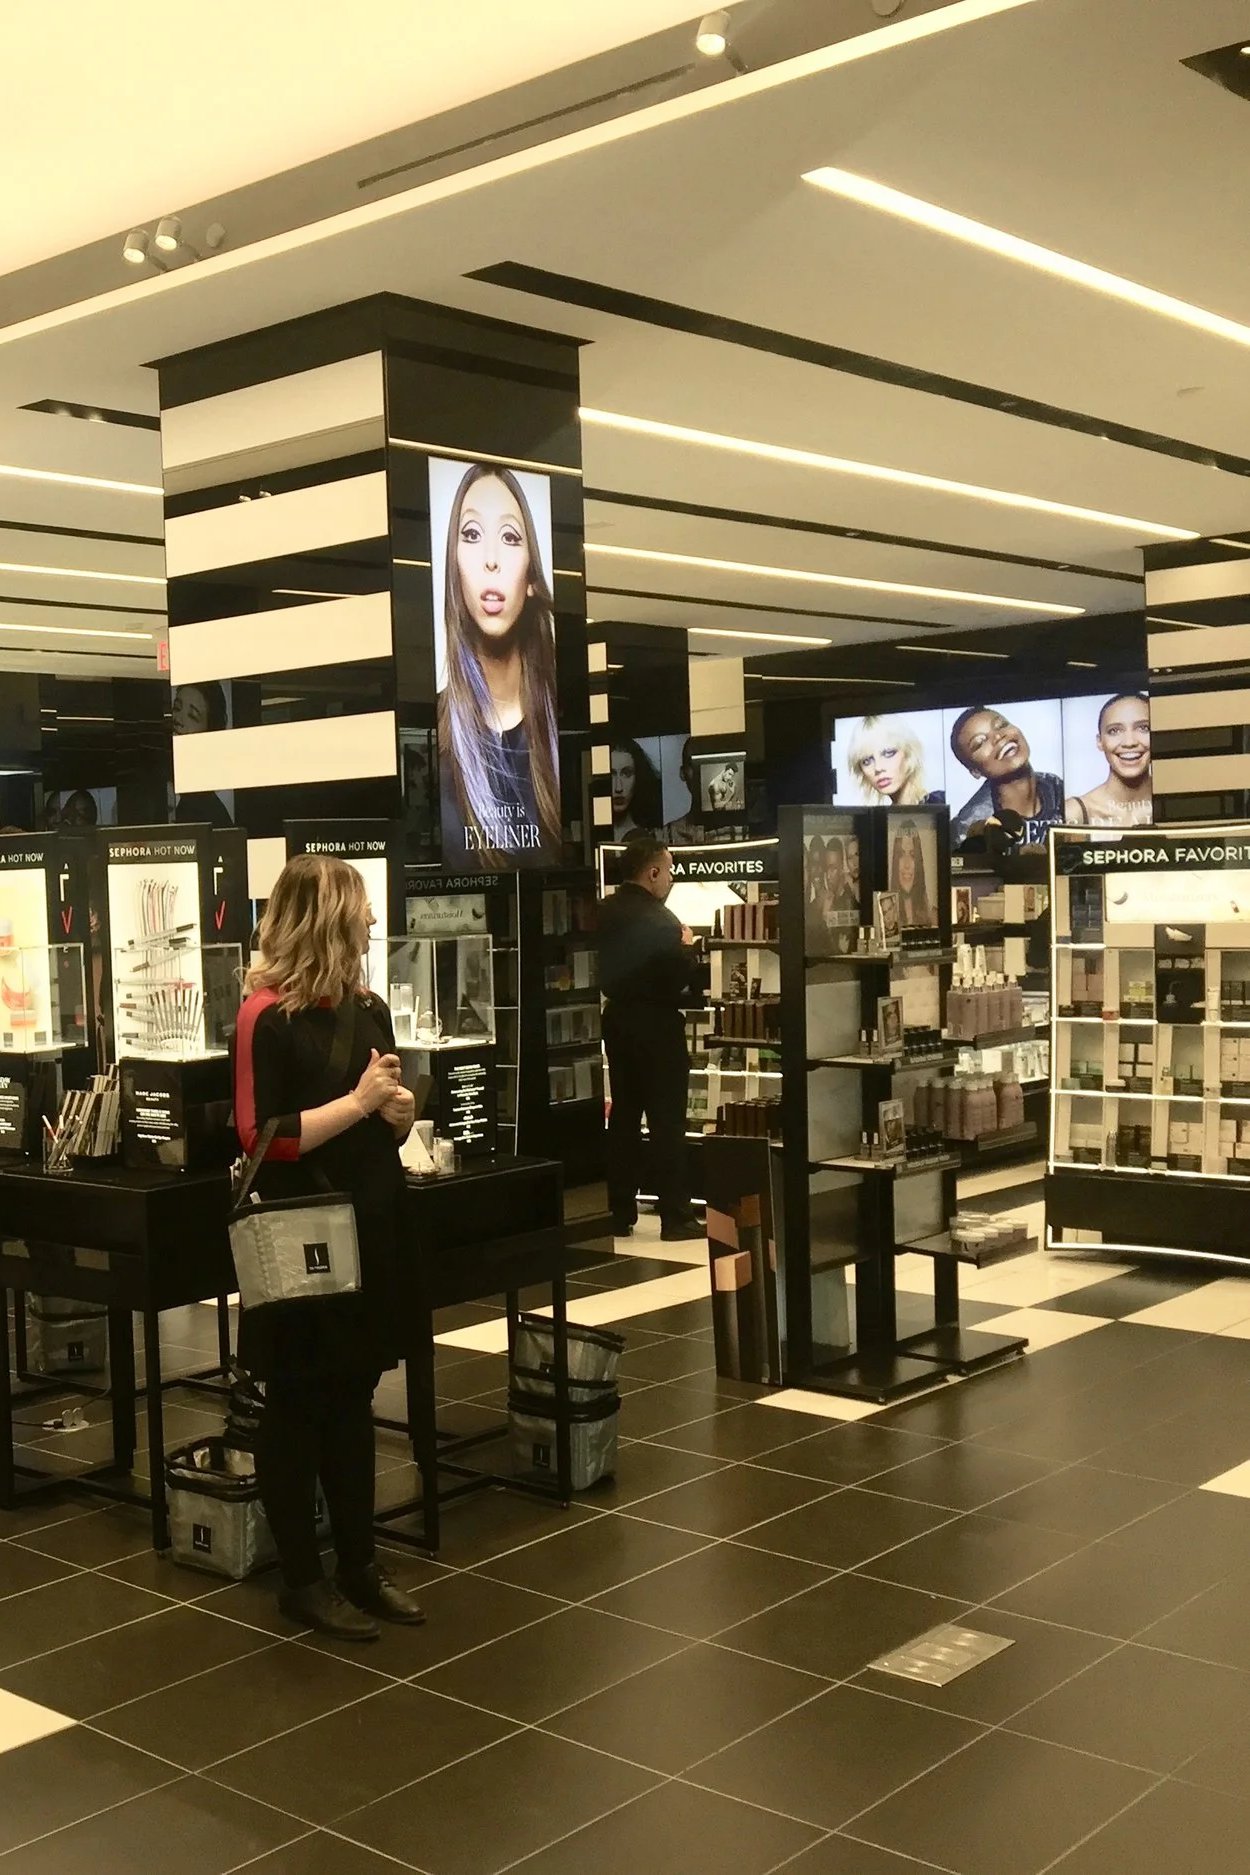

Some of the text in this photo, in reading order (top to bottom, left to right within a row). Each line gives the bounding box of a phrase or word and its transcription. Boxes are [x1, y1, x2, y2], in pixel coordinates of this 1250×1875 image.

[478, 802, 526, 821] Beauty is
[464, 824, 542, 850] EYELINER
[109, 845, 195, 858] SEPHORA HOT NOW
[305, 841, 386, 853] SEPHORA HOT NOW
[8, 854, 24, 864] HOT
[25, 853, 44, 863] NOW
[1082, 849, 1169, 865] SEPHORA
[689, 860, 764, 875] FAVORITES
